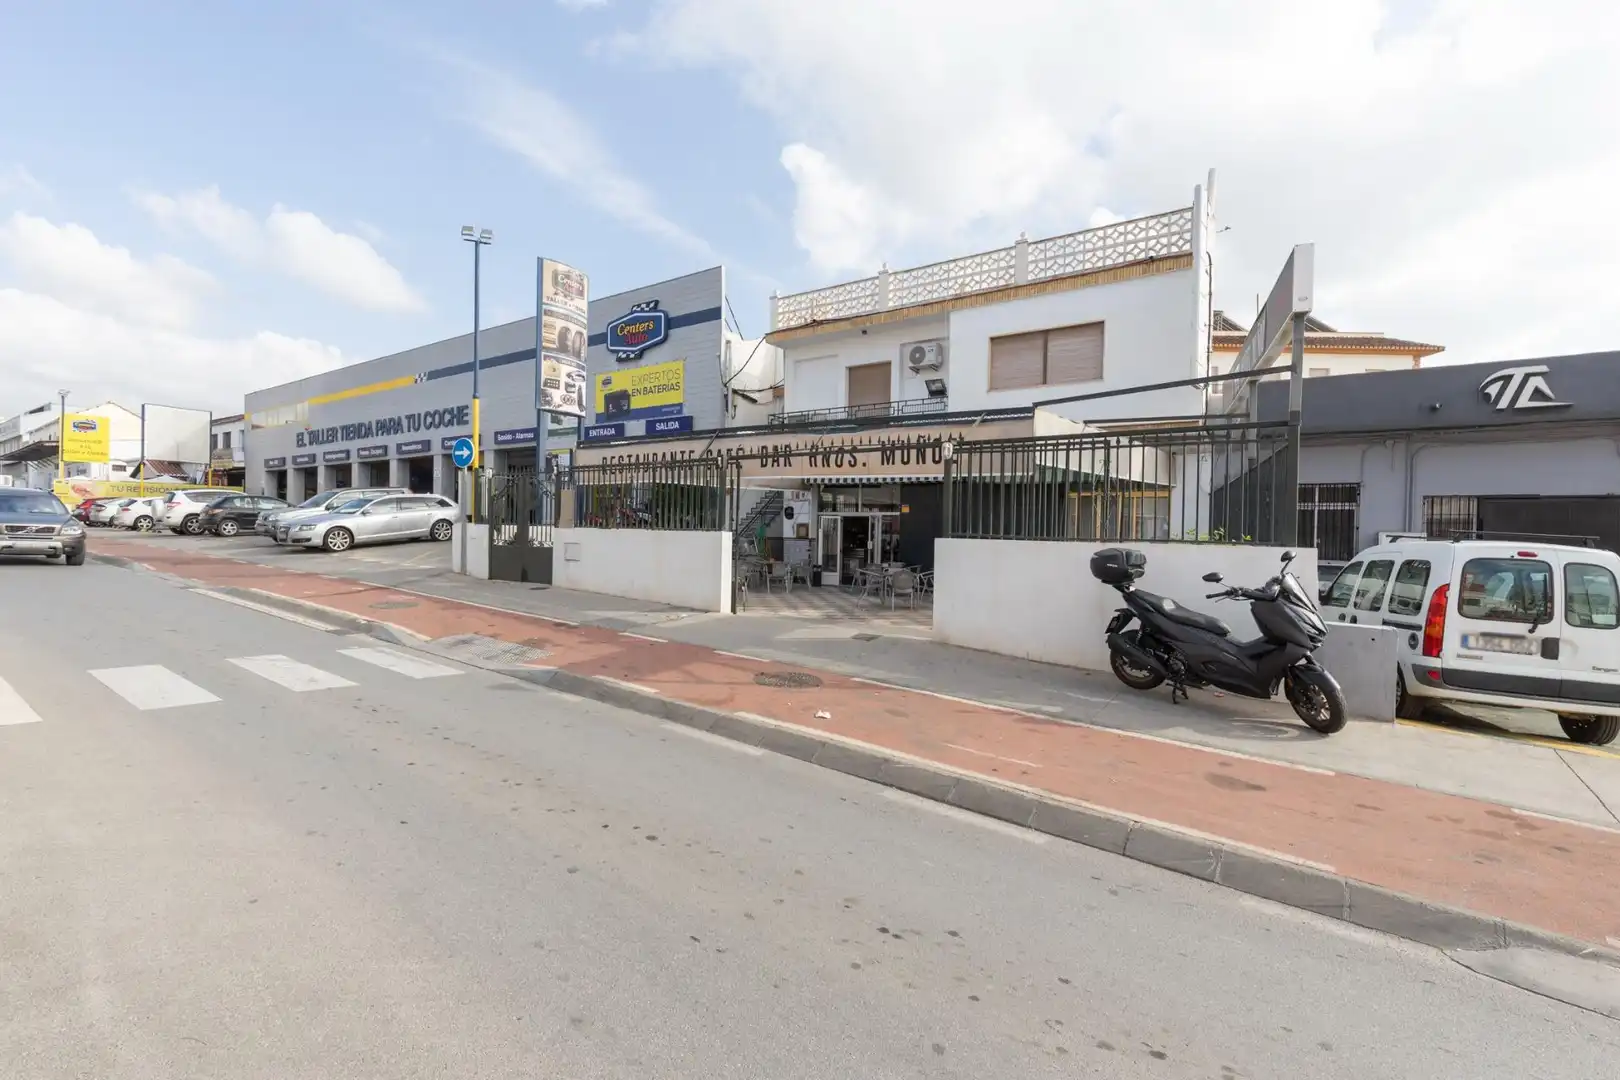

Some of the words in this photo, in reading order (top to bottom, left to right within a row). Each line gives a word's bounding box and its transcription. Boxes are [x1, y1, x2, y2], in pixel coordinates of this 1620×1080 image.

[617, 320, 655, 336] Centers
[624, 333, 649, 345] Auto
[631, 368, 681, 387] EXPERTOS
[631, 387, 642, 398] EN
[642, 381, 681, 396] BATERÍAS
[296, 431, 307, 448] EL
[307, 427, 339, 446] TALLER
[340, 420, 375, 442] TIENDA
[375, 417, 404, 437] PARA
[404, 412, 422, 432] TU
[422, 404, 470, 430] COCHE
[588, 428, 616, 437] ENTRADA
[655, 420, 680, 431] SALIDA
[601, 450, 696, 476] RESTAURANTE
[760, 445, 792, 468] BAR
[880, 435, 958, 466] MUÑO
